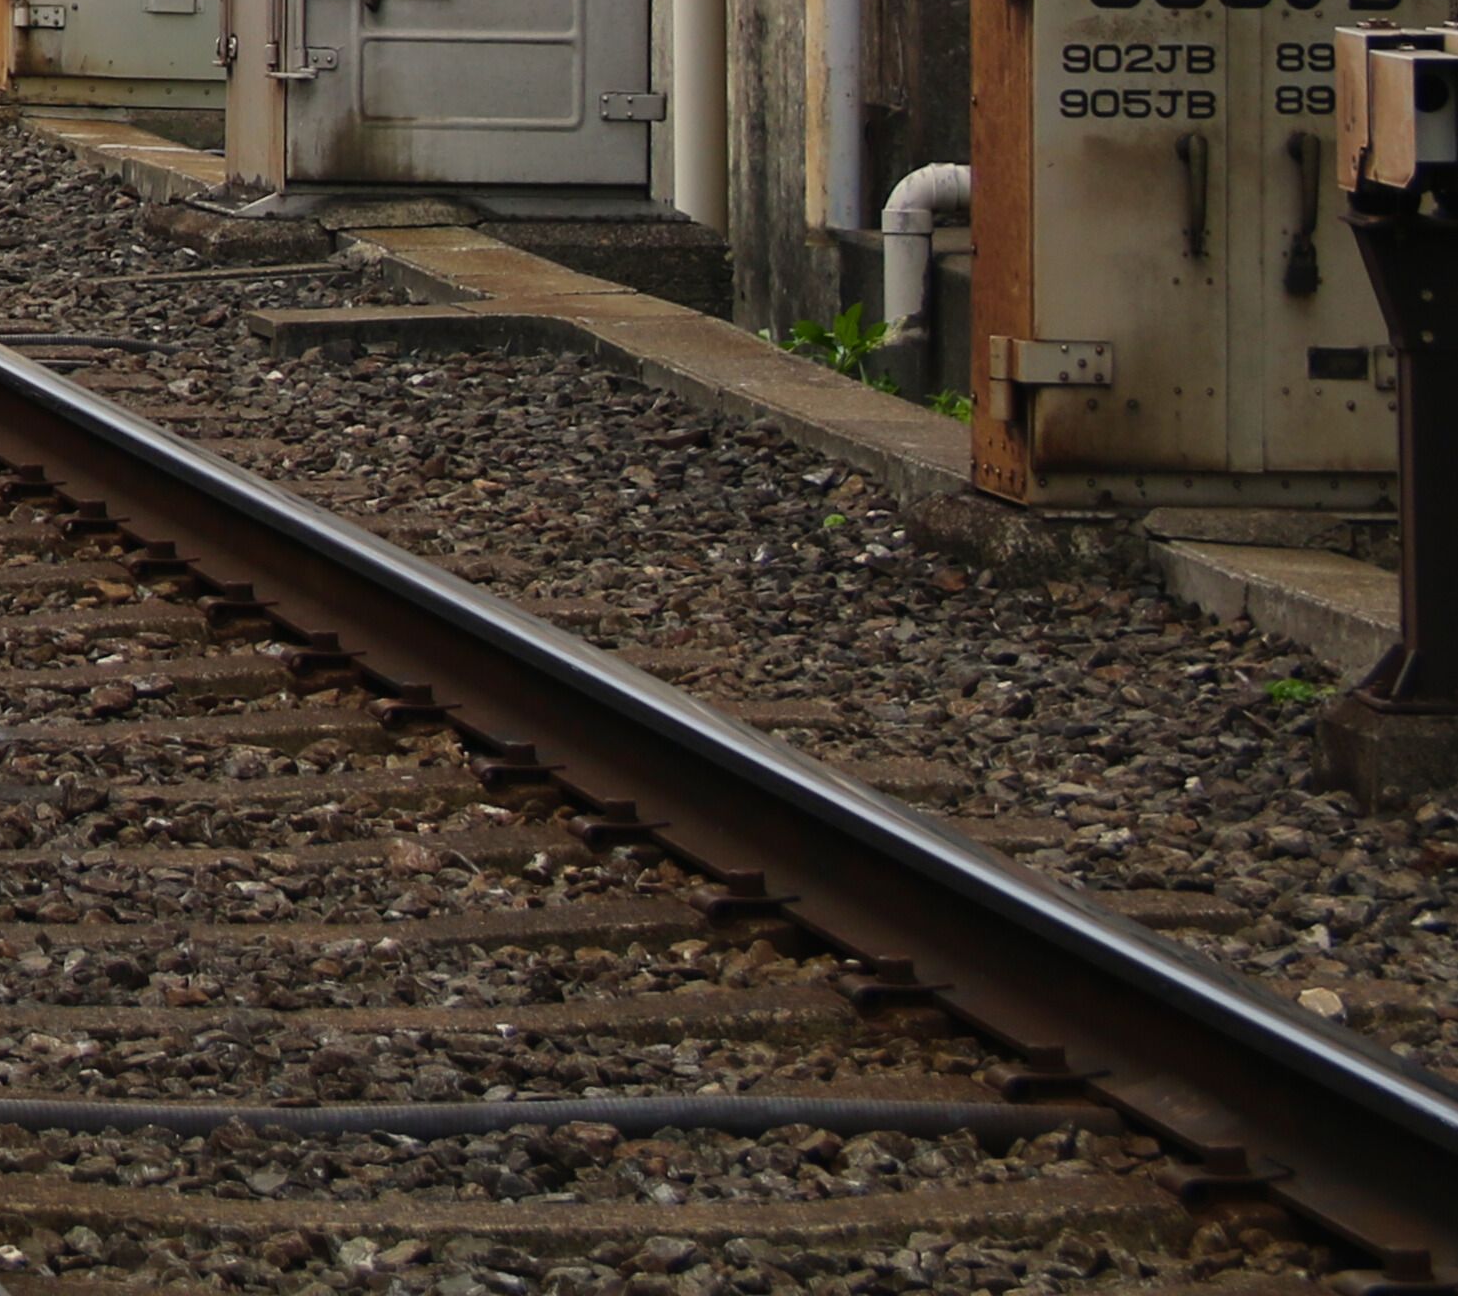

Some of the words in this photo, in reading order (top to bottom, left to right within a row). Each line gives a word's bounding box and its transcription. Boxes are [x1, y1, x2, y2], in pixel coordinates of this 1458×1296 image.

[1062, 44, 1215, 74] 902JB
[1276, 43, 1336, 72] 89
[1059, 89, 1215, 120] 905JB
[1275, 85, 1336, 114] 89
